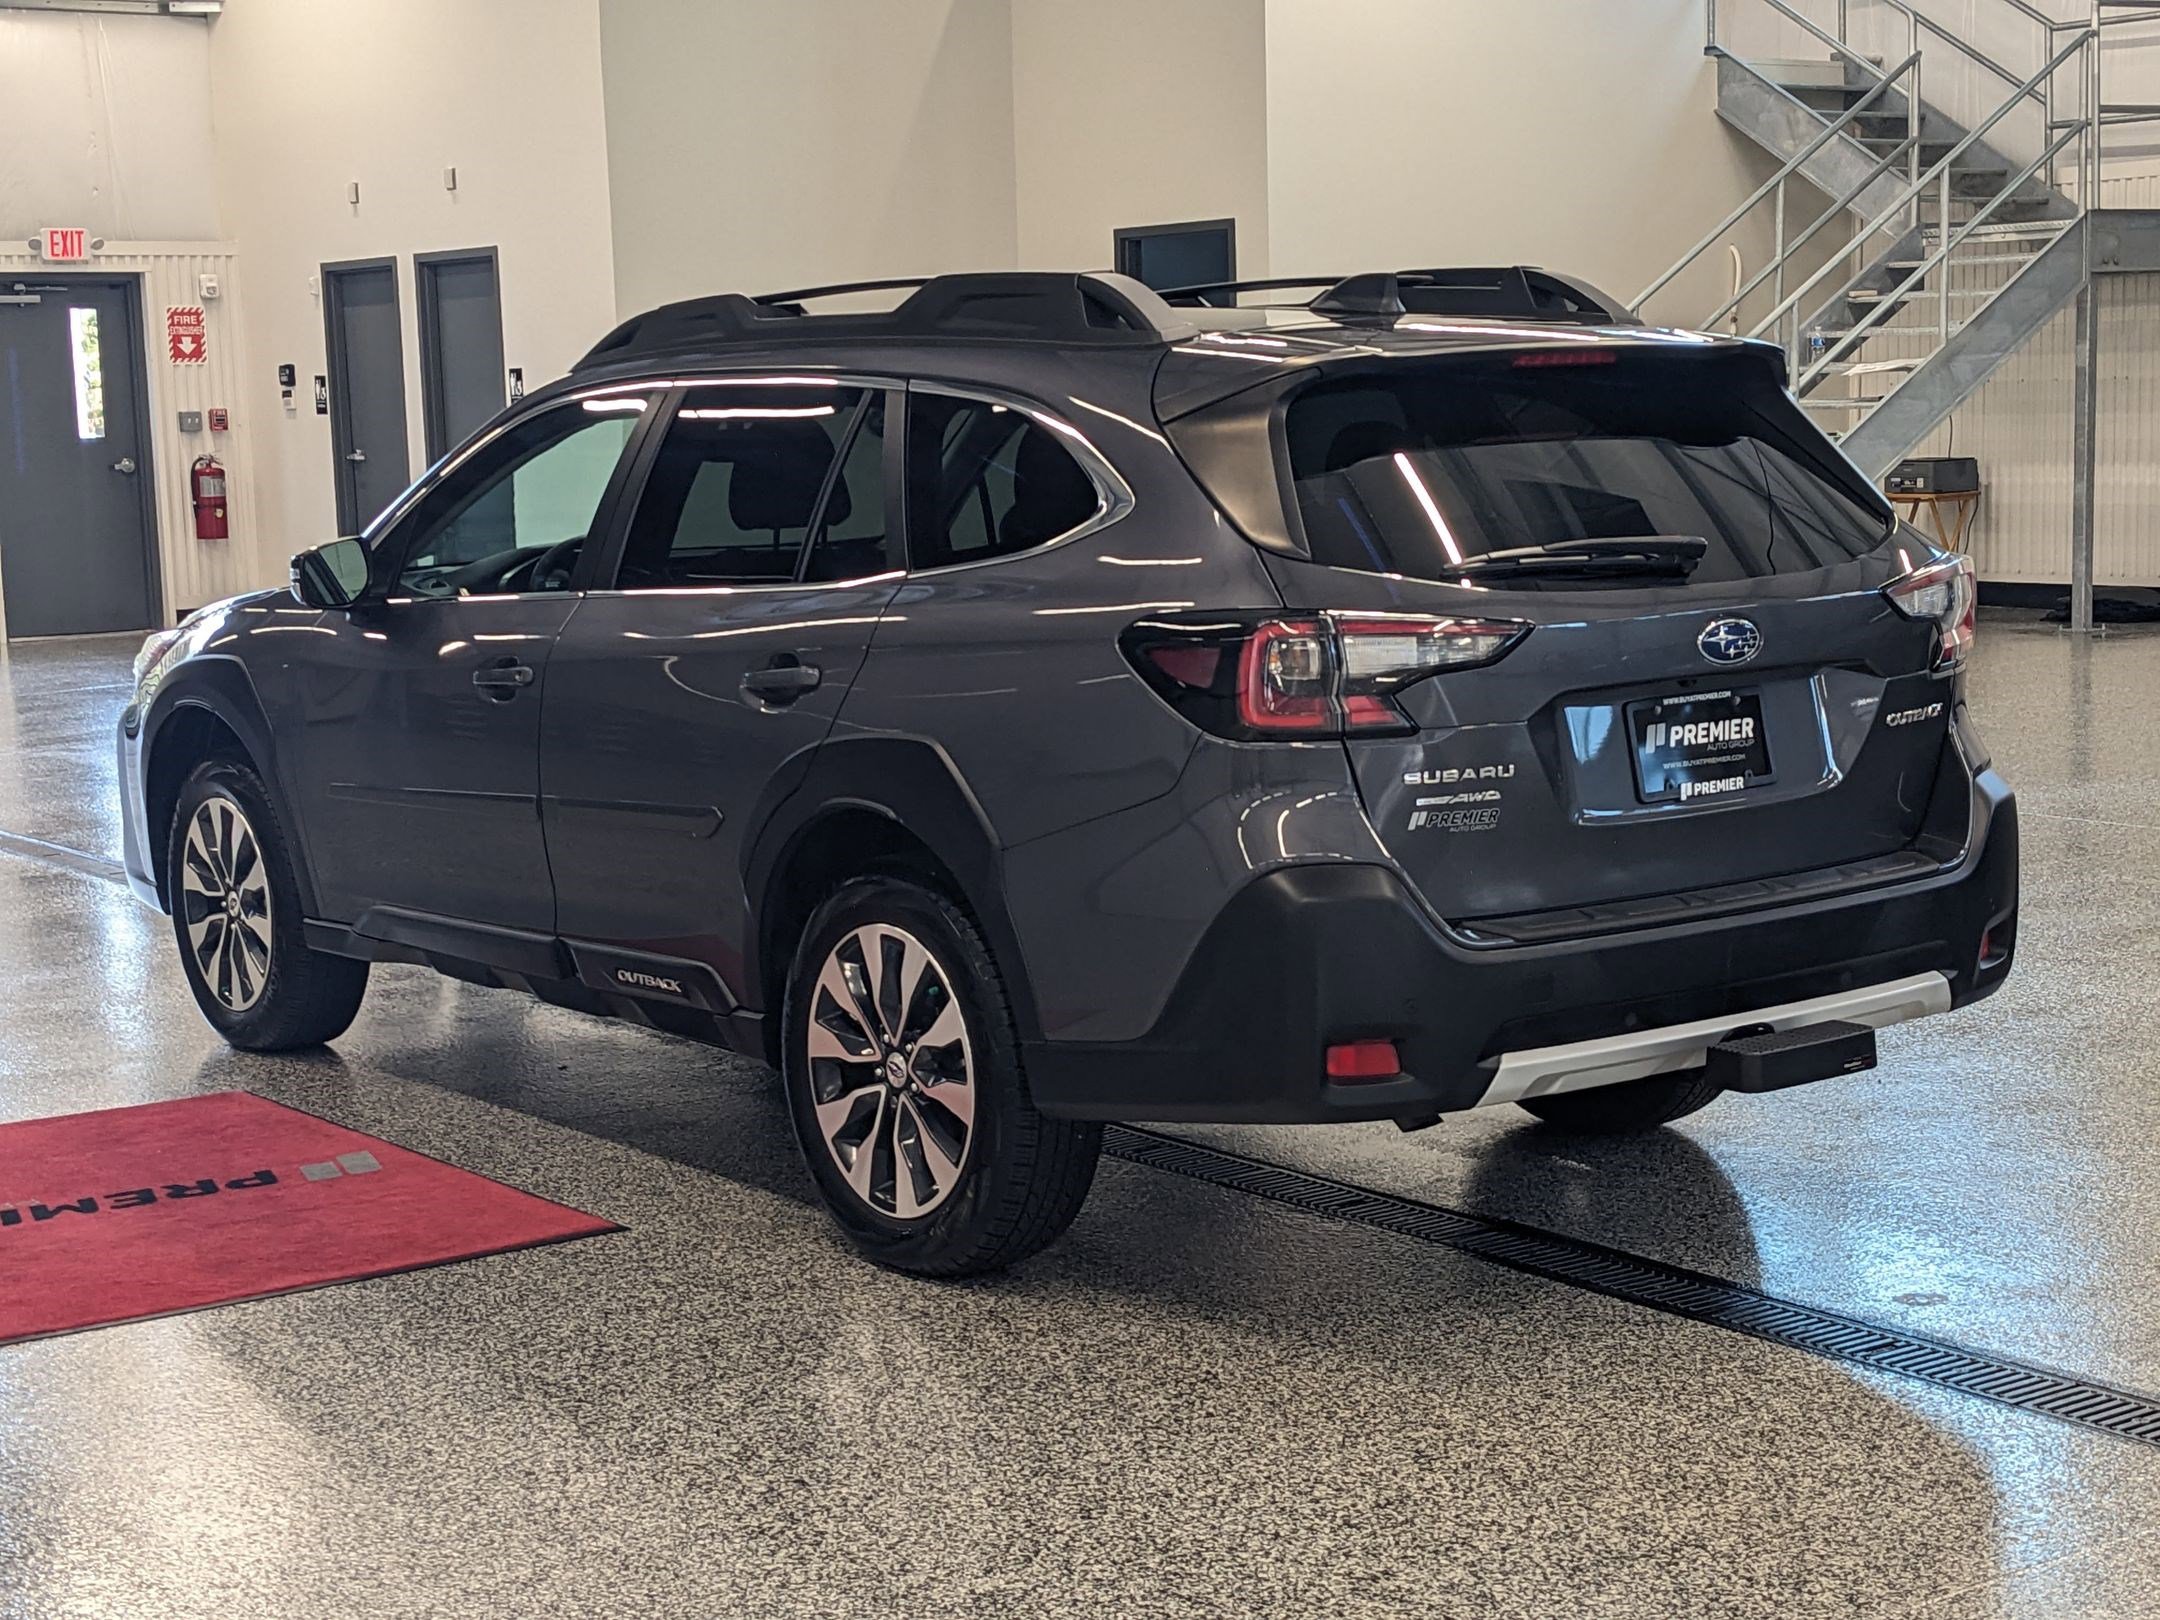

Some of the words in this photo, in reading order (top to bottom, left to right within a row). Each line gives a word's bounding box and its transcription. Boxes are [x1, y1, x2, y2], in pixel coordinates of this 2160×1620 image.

[50, 230, 84, 257] EXIT
[173, 315, 198, 325] FIRE
[1669, 717, 1755, 748] PREMIER
[1706, 741, 1728, 751] AUTO
[1728, 739, 1755, 750] GROUP
[1403, 764, 1515, 785] SUBARU
[1693, 776, 1745, 796] PREMIER
[1448, 789, 1502, 804] AWD
[1426, 808, 1500, 827] PREMIER
[1449, 825, 1469, 833] AUTO
[1470, 823, 1497, 831] GROUP
[617, 969, 682, 993] OUTBACK
